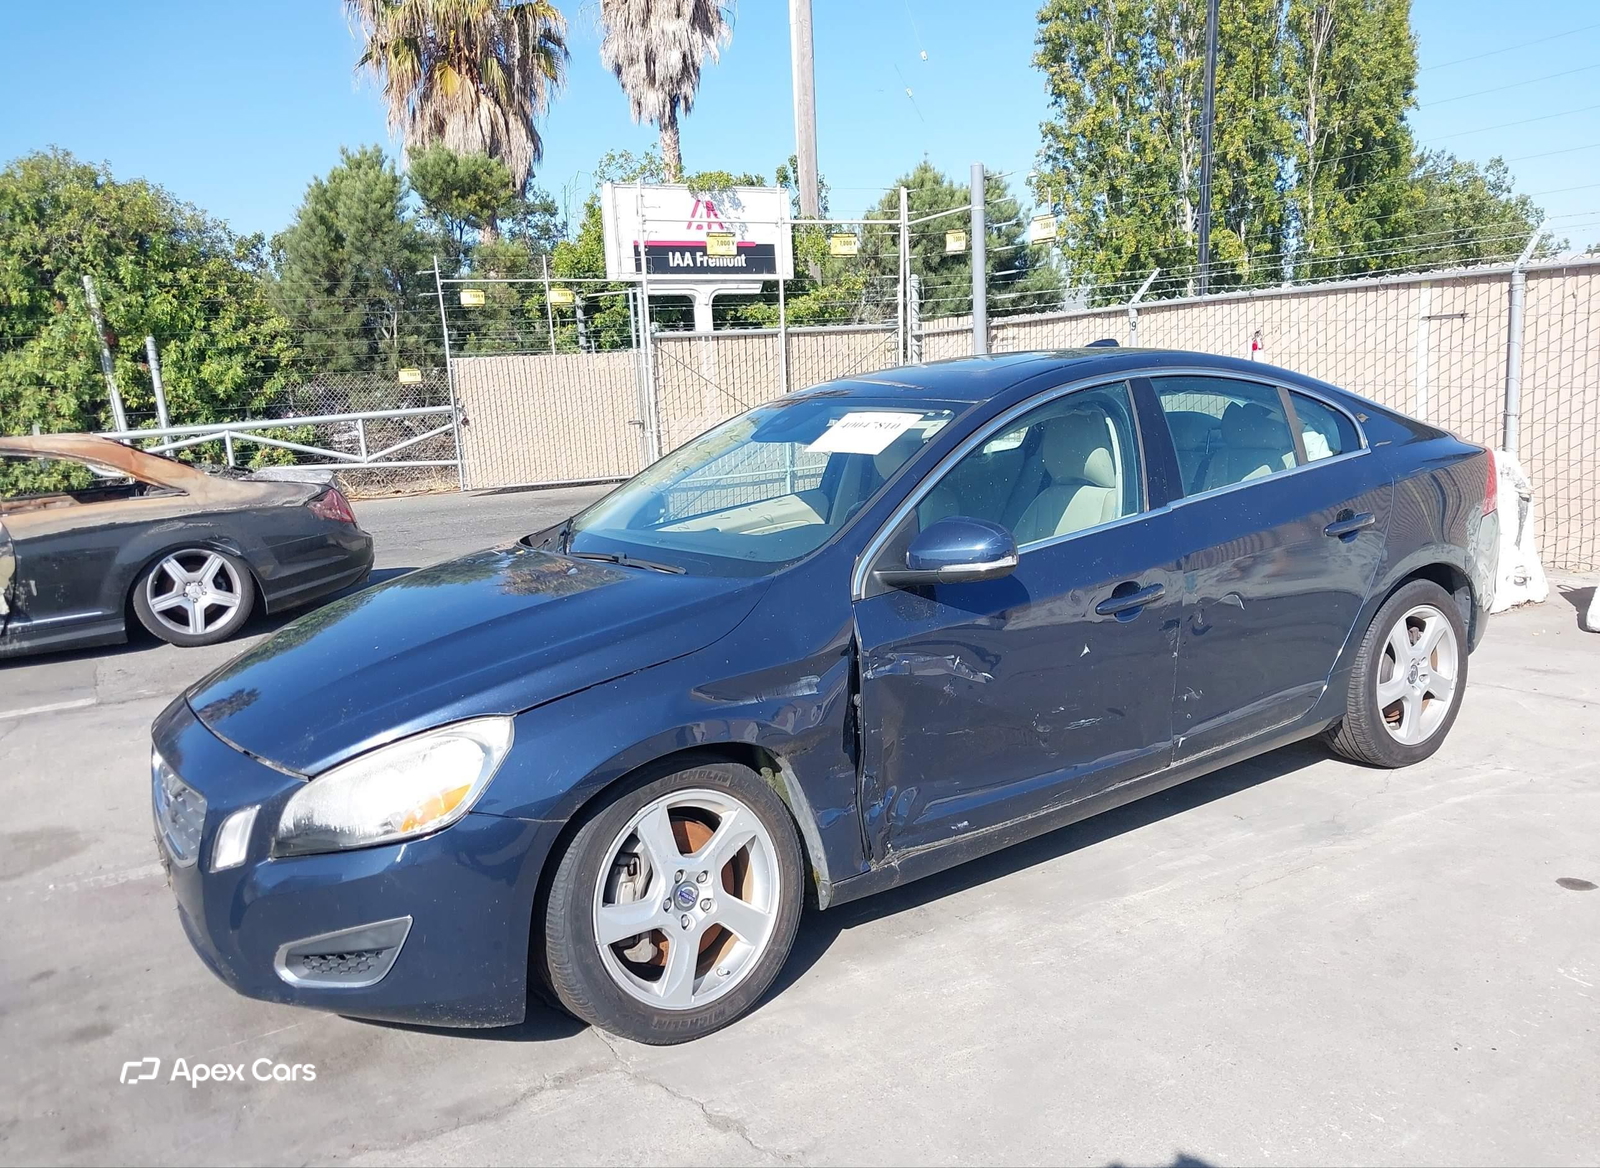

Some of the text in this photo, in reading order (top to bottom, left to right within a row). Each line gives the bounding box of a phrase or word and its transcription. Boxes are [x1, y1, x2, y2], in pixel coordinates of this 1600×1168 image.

[668, 251, 746, 267] IAA Fremont
[1131, 320, 1137, 331] 9
